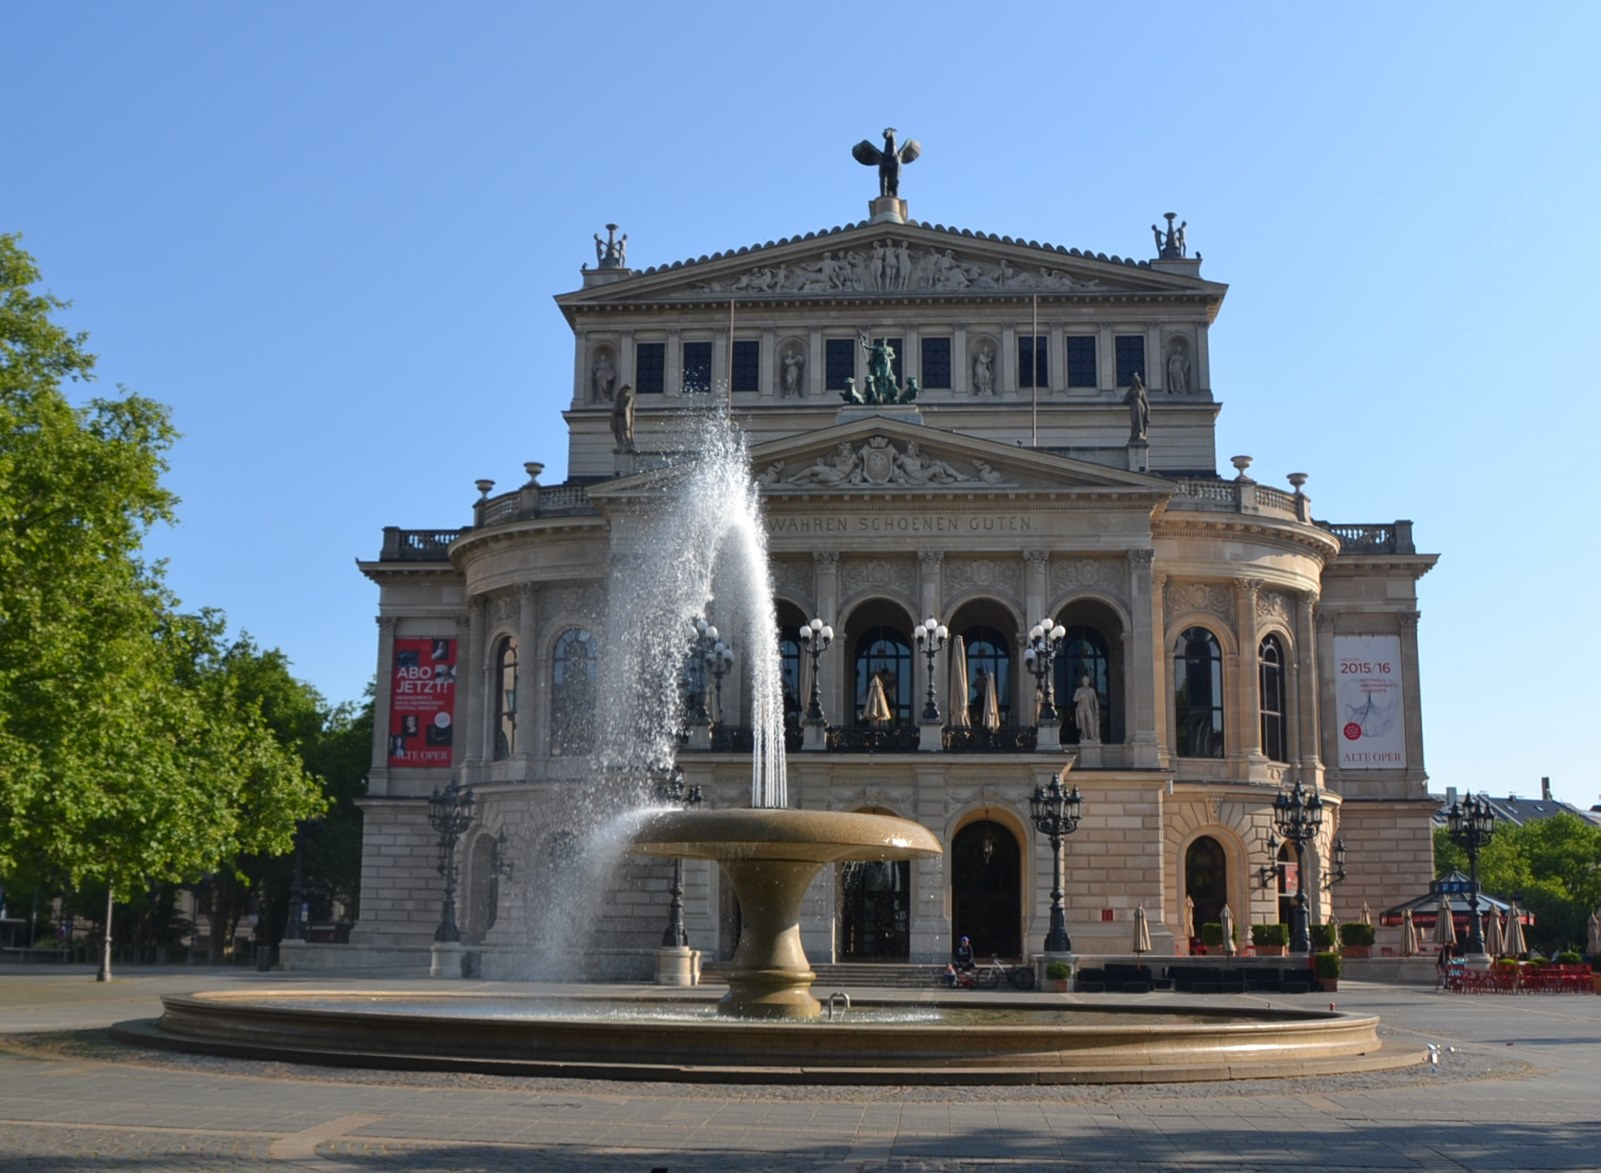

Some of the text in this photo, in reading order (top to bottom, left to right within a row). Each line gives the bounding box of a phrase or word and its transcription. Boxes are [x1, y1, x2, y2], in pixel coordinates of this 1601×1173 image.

[768, 516, 1039, 532] WAHREN SCHOENEN GUTEN.
[397, 667, 432, 679] ABO
[1340, 660, 1391, 675] 2015/16
[396, 681, 447, 693] JETZT!
[394, 752, 448, 760] ALTE OPER
[1343, 752, 1401, 761] ALTE OPER
